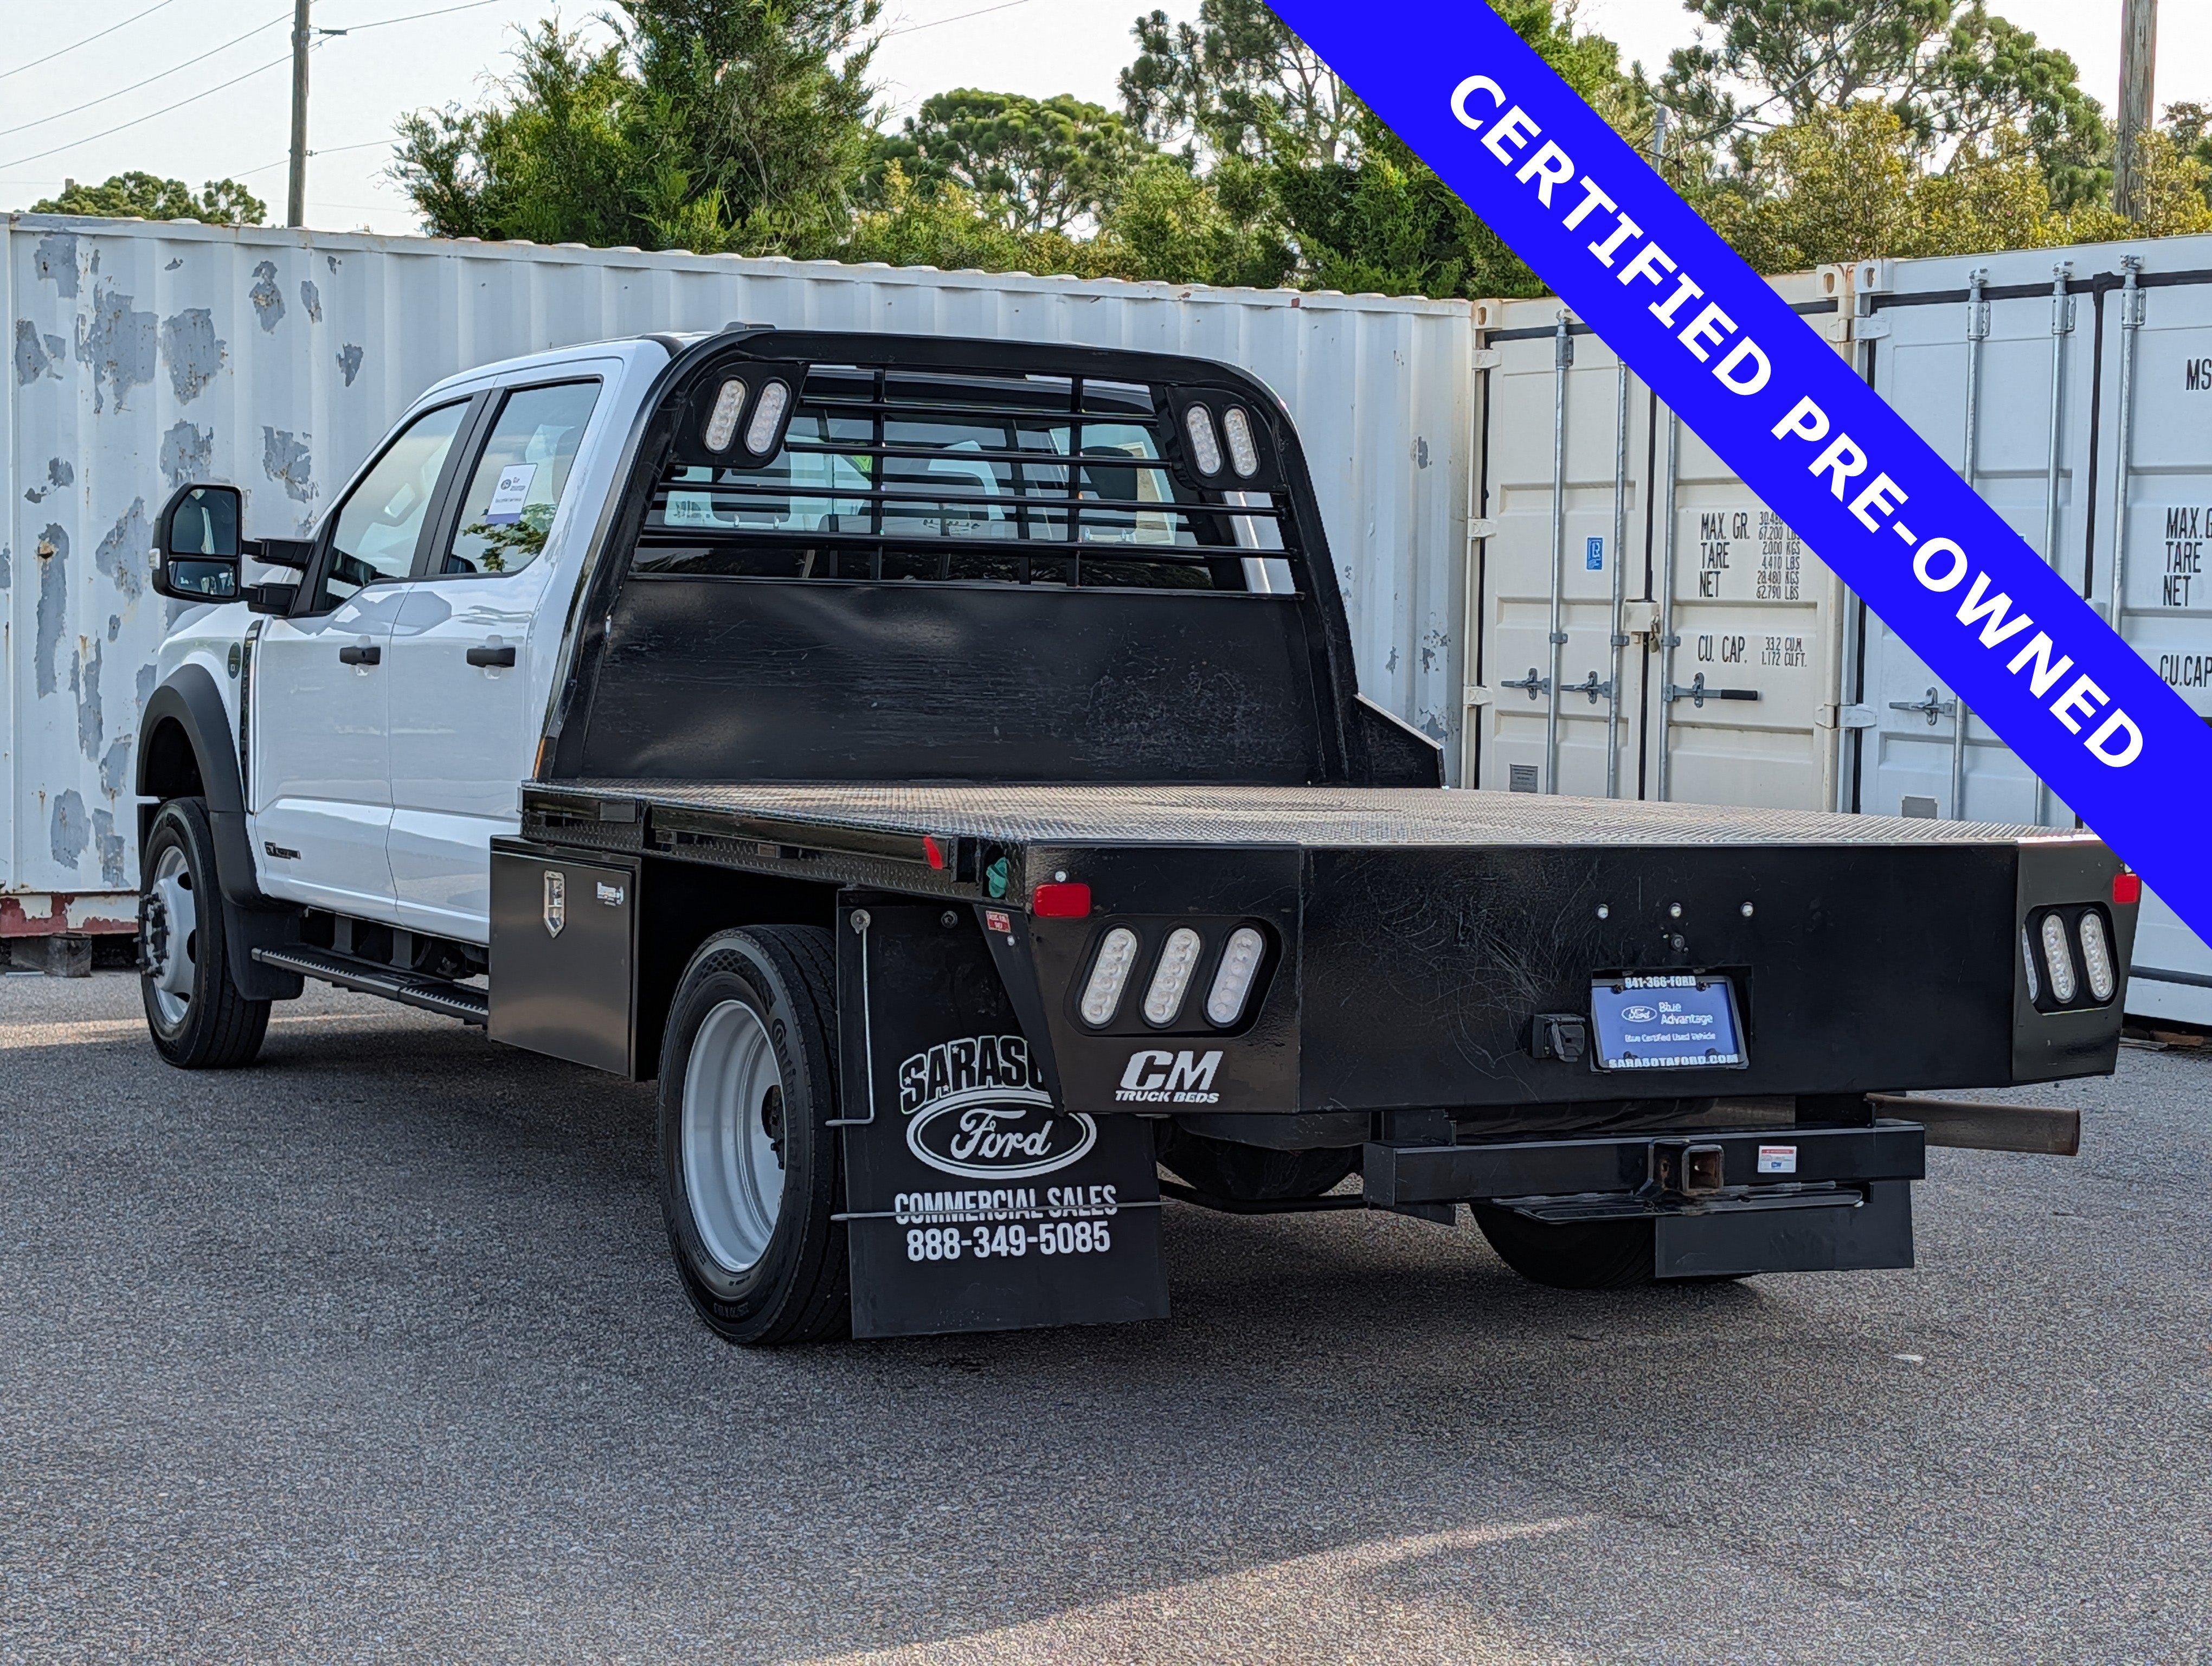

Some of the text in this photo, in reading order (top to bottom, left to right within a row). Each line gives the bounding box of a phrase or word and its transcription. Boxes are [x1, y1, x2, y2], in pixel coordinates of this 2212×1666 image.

[1701, 512, 1750, 540] MAX. GR.
[1787, 527, 1800, 540] LB
[1701, 542, 1730, 569] TARE
[1786, 541, 1800, 555] KGS
[2165, 541, 2203, 573] TARE
[1786, 556, 1800, 570] LBS
[1700, 571, 1721, 598] NET
[1785, 571, 1799, 585] KGS
[2163, 575, 2191, 606] NET
[1785, 586, 1798, 600] LBS
[1698, 635, 1747, 663] CU. CAP.
[1659, 1002, 1682, 1013] Blue
[1661, 1013, 1713, 1026] Advantage
[1120, 1050, 1224, 1090] CM
[1115, 1090, 1219, 1104] TRUCK BEDS
[950, 1108, 1053, 1159] Ford
[895, 1185, 1118, 1225] COMMERCIAL SALES
[906, 1221, 1110, 1261] 888-349-5085
